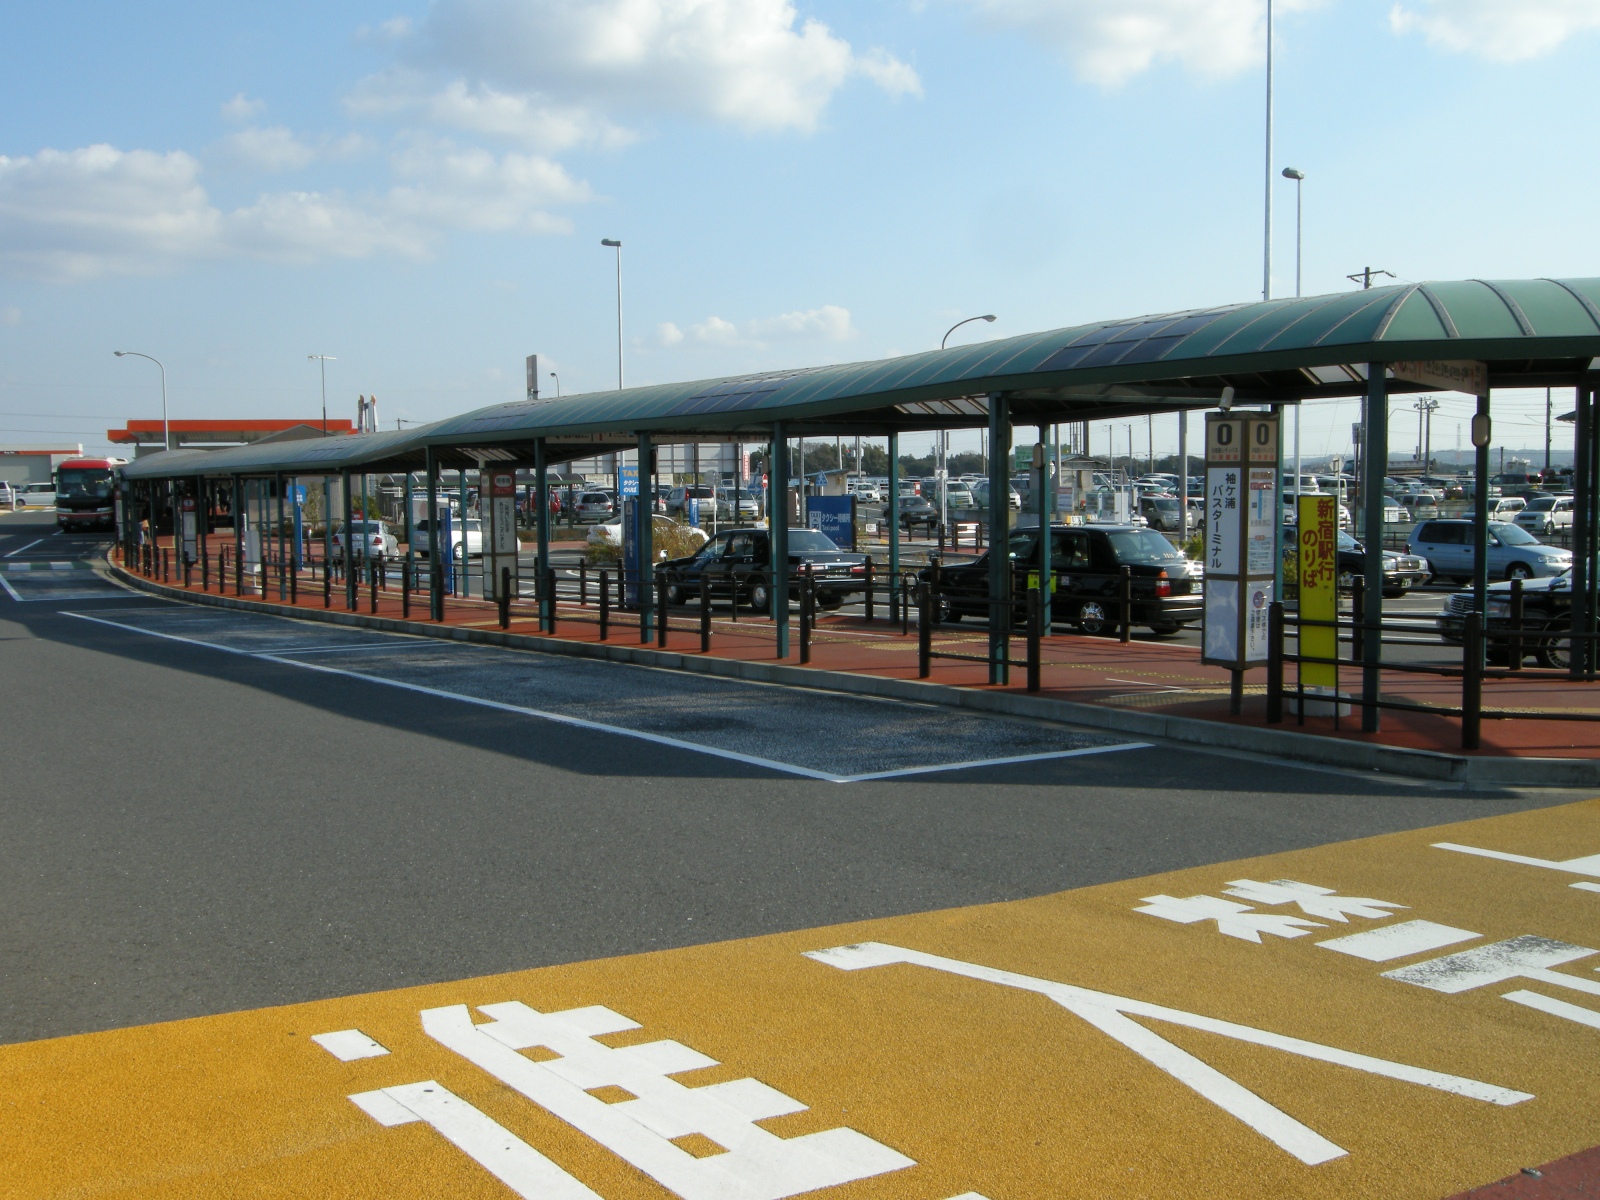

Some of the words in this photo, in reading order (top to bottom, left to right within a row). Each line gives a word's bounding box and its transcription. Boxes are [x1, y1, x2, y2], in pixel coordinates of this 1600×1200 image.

[1217, 423, 1233, 446] 0
[1256, 423, 1270, 446] 0
[622, 469, 639, 477] TAX
[1211, 484, 1223, 569] バスターミナル
[1317, 498, 1335, 581] 新宿駅行
[1302, 529, 1319, 589] のりば
